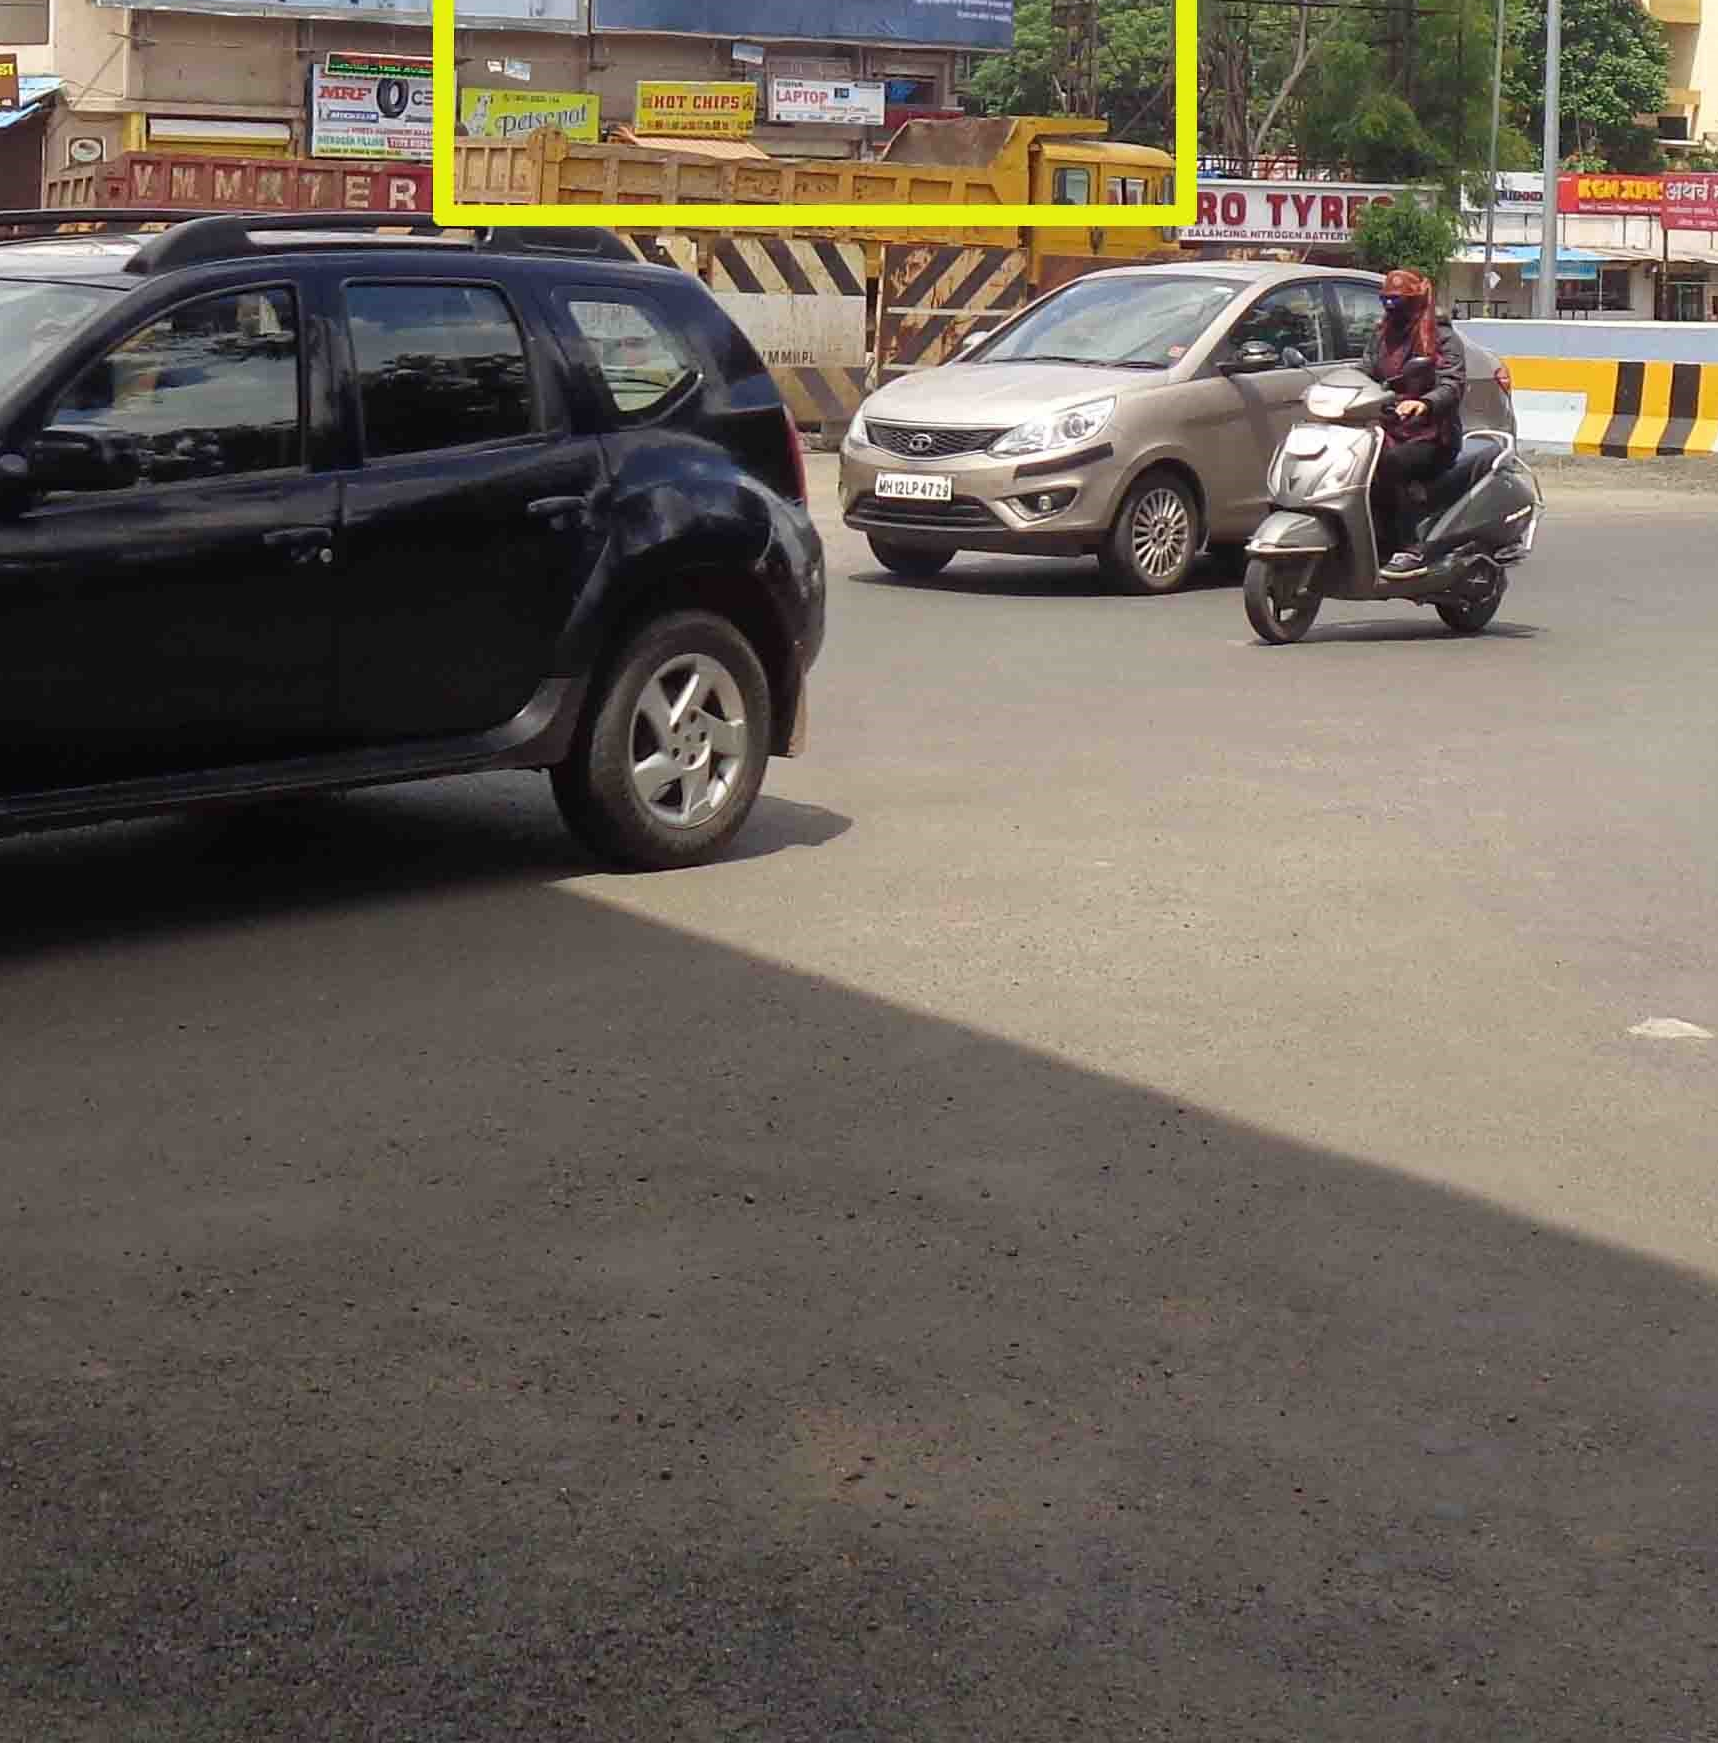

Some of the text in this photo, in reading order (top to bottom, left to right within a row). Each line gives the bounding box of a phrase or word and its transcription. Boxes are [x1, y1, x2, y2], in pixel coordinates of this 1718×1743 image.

[319, 85, 372, 101] MRF
[776, 89, 828, 105] LAPTOP
[653, 95, 740, 110] HOT CHIPS
